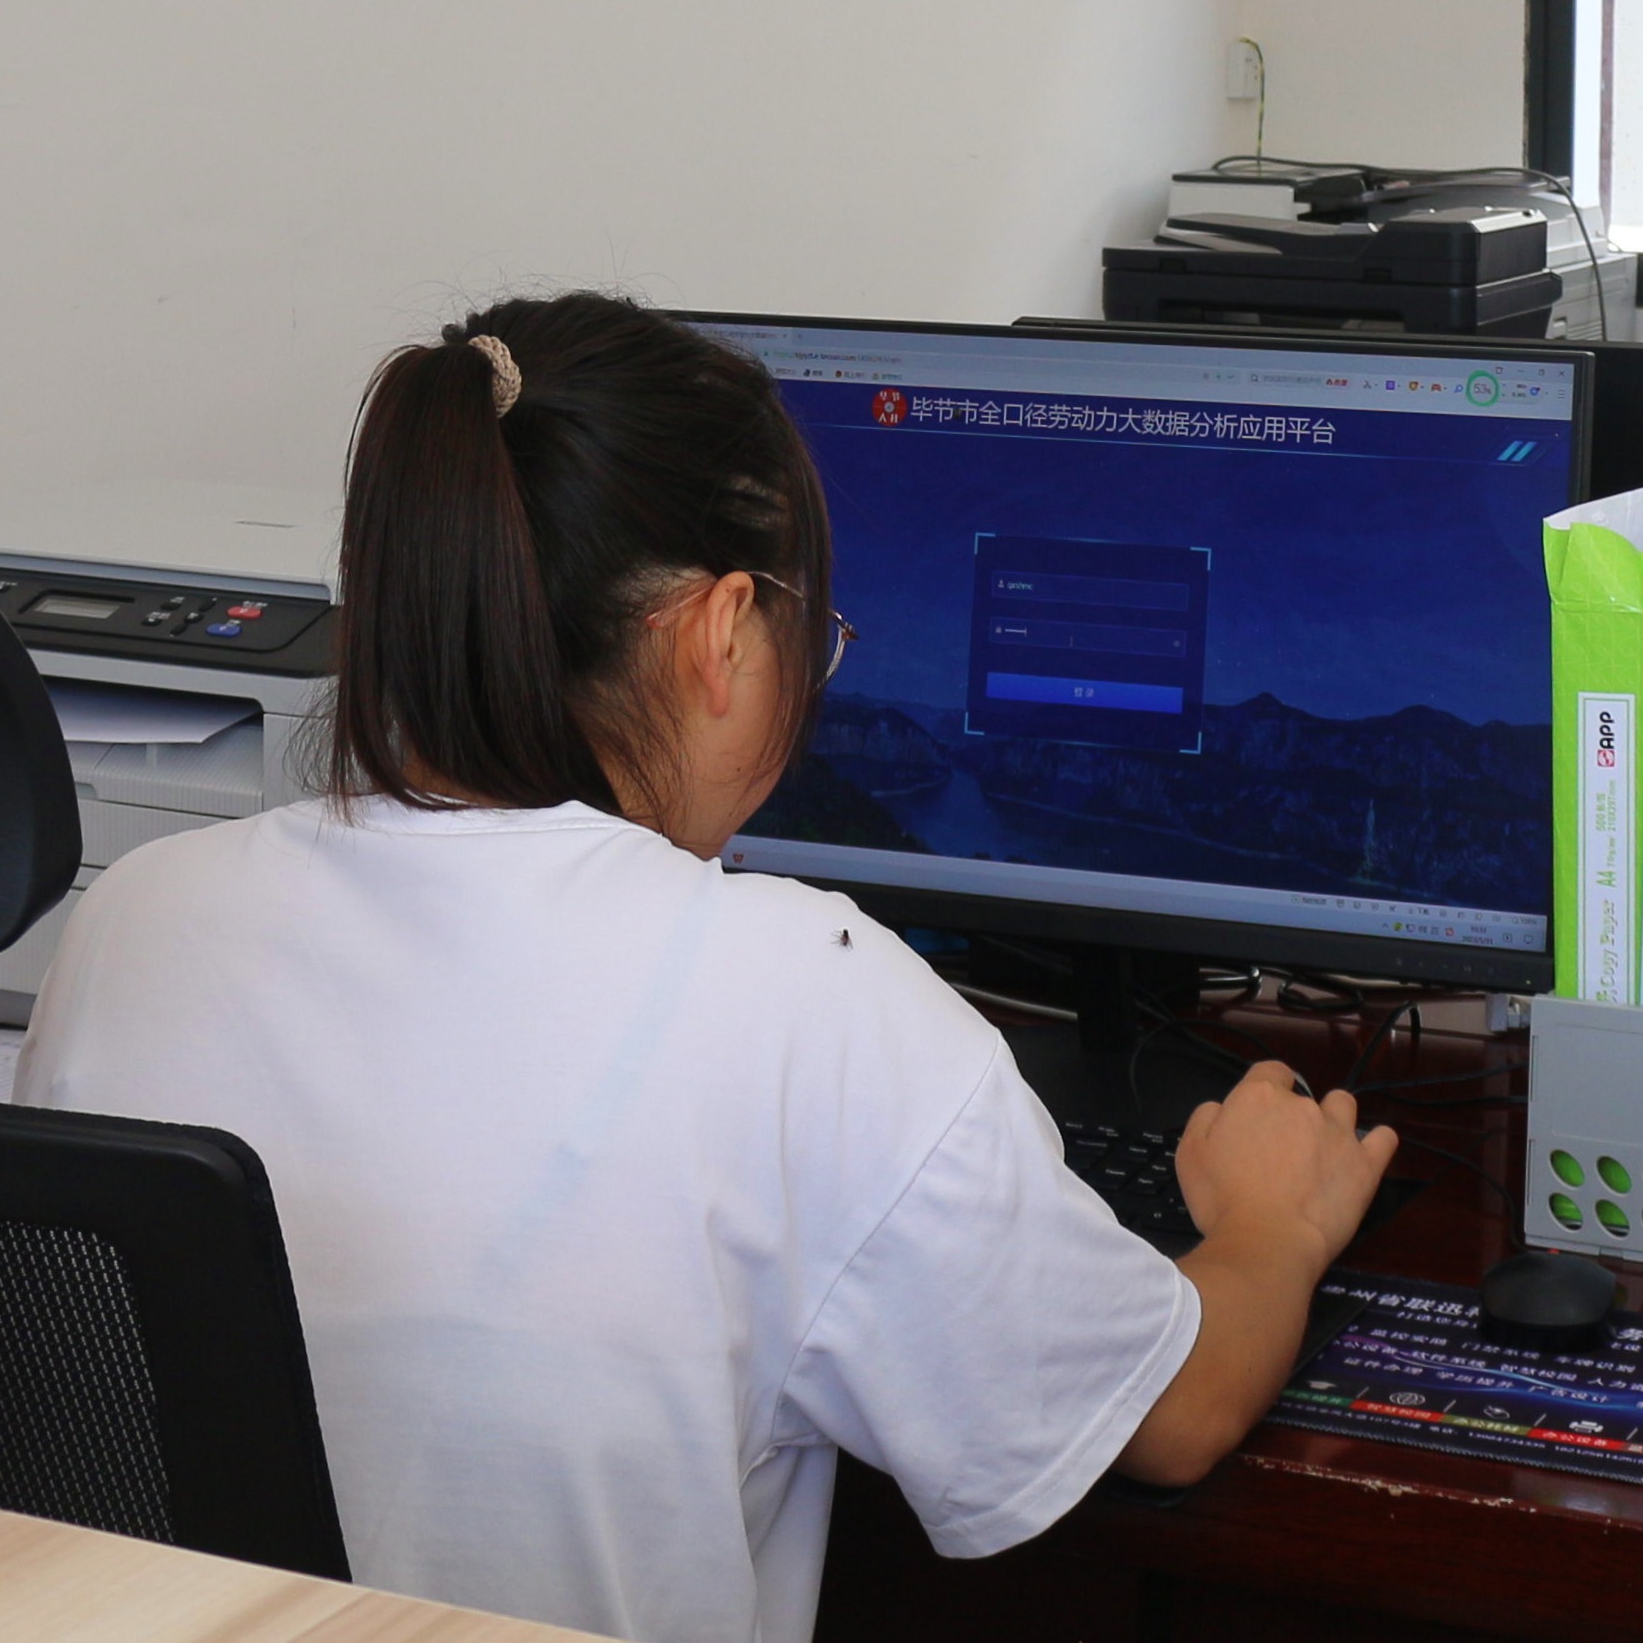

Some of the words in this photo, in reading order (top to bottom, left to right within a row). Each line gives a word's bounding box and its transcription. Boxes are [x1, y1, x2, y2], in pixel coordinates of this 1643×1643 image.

[910, 395, 1337, 445] 毕节市全口径劳动力大数据分析应用平台
[1599, 711, 1615, 749] APP
[1596, 870, 1617, 888] A4
[1600, 900, 1618, 947] Paper
[1601, 949, 1618, 988] Copy
